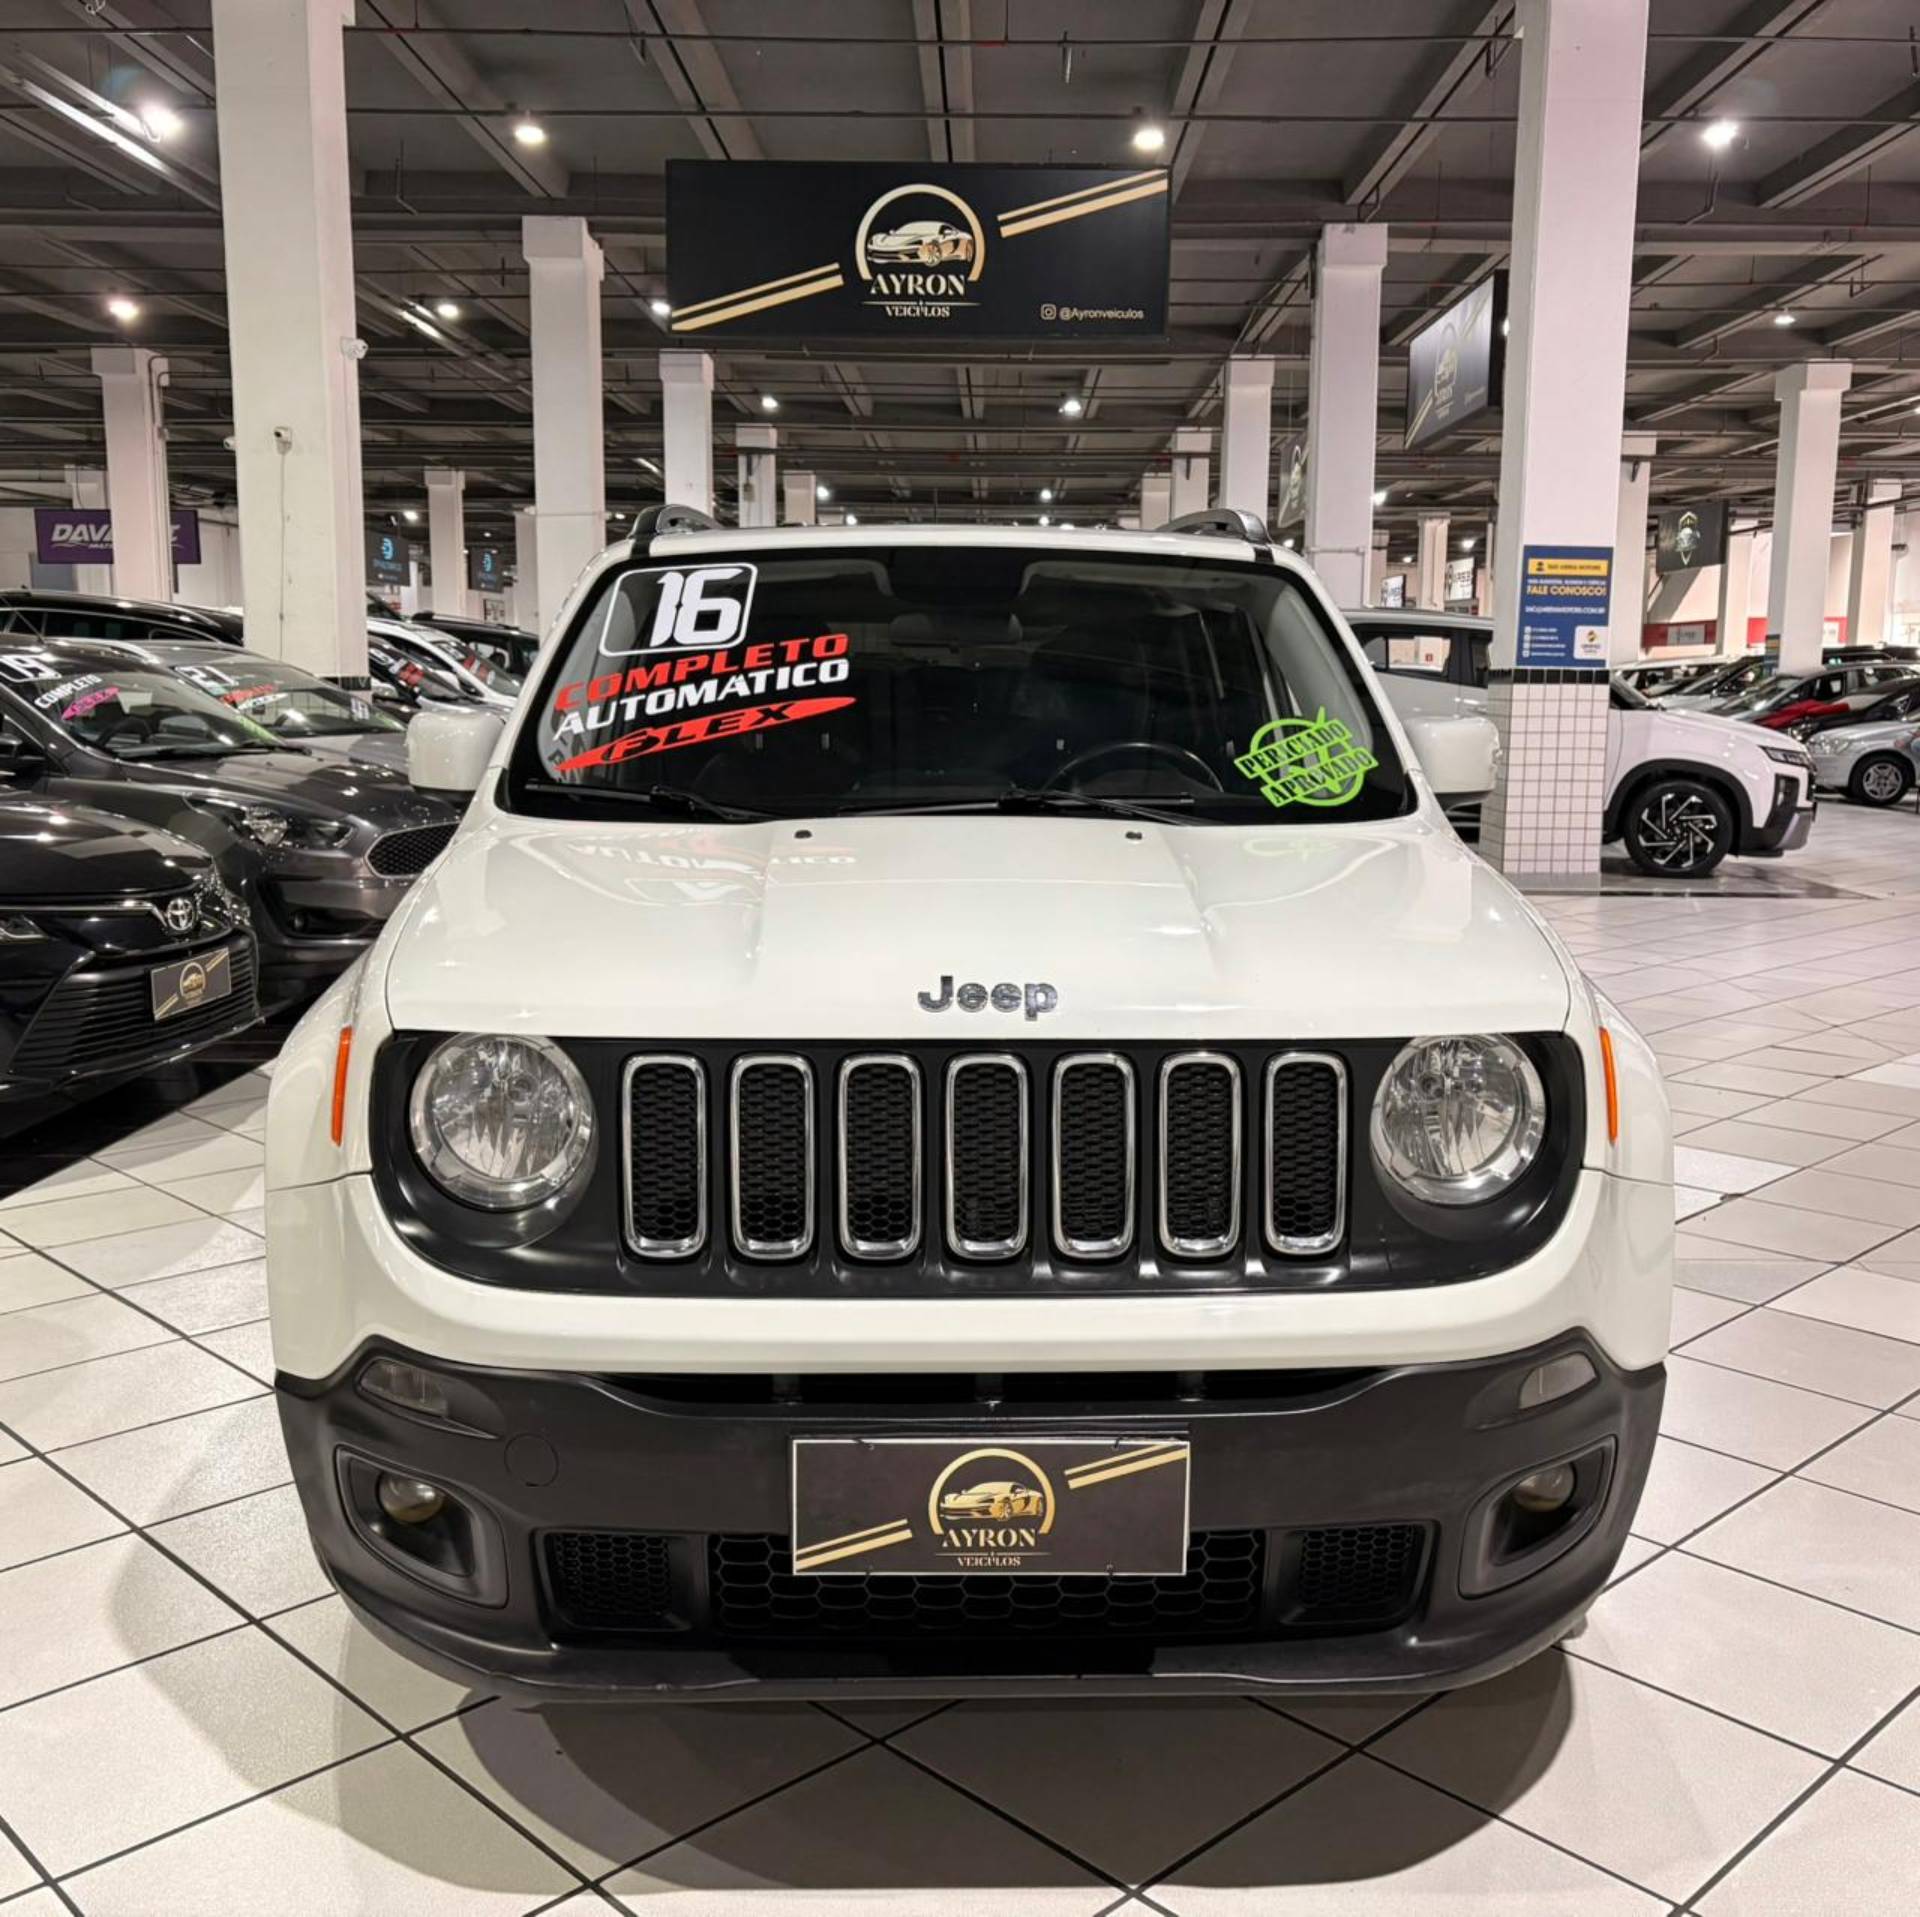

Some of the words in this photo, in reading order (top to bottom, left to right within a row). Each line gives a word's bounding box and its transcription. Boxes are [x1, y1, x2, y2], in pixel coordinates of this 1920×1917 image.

[869, 273, 966, 296] AYRON
[649, 567, 743, 648] 16
[34, 674, 103, 709] COMPLETO
[553, 633, 849, 712] COMPLETO
[600, 702, 797, 764] FLEX
[1238, 722, 1347, 775] PERICIADO
[1268, 749, 1373, 804] APROVADO
[917, 975, 1059, 1022] Jeep
[941, 1528, 1036, 1548] AYRON
